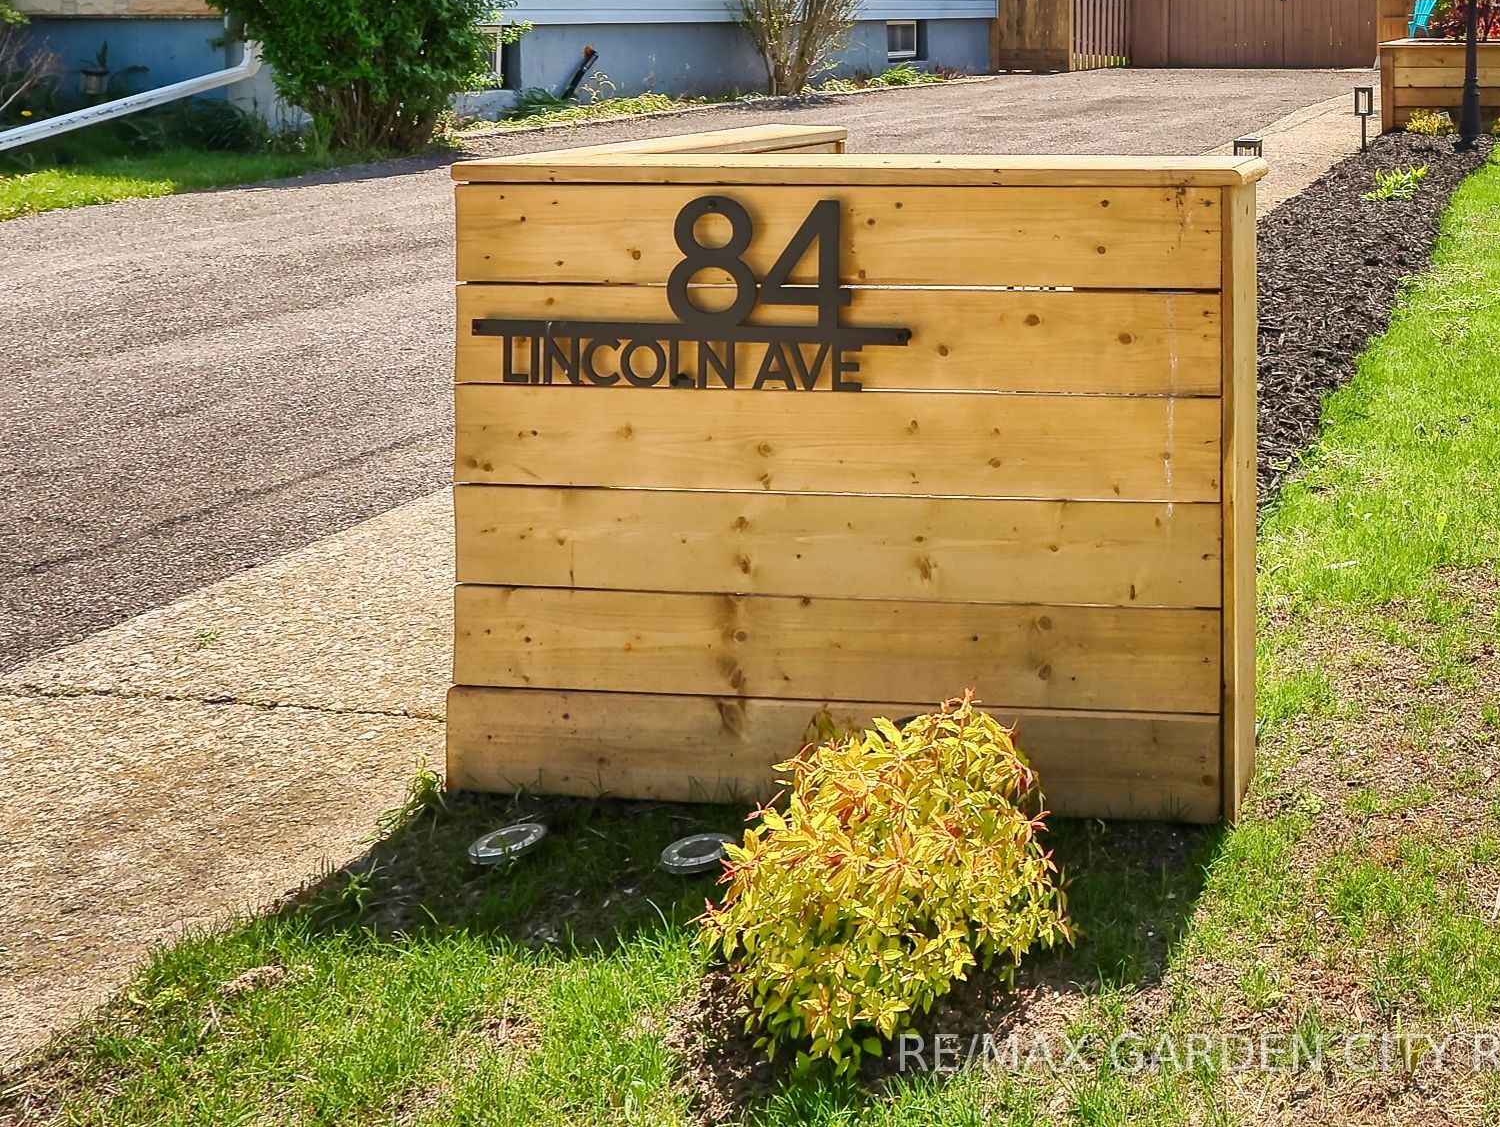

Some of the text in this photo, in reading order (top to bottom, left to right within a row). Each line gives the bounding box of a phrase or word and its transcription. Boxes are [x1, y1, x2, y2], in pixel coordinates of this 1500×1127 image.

[667, 195, 852, 328] 84
[502, 336, 863, 392] LINCOLN AVE
